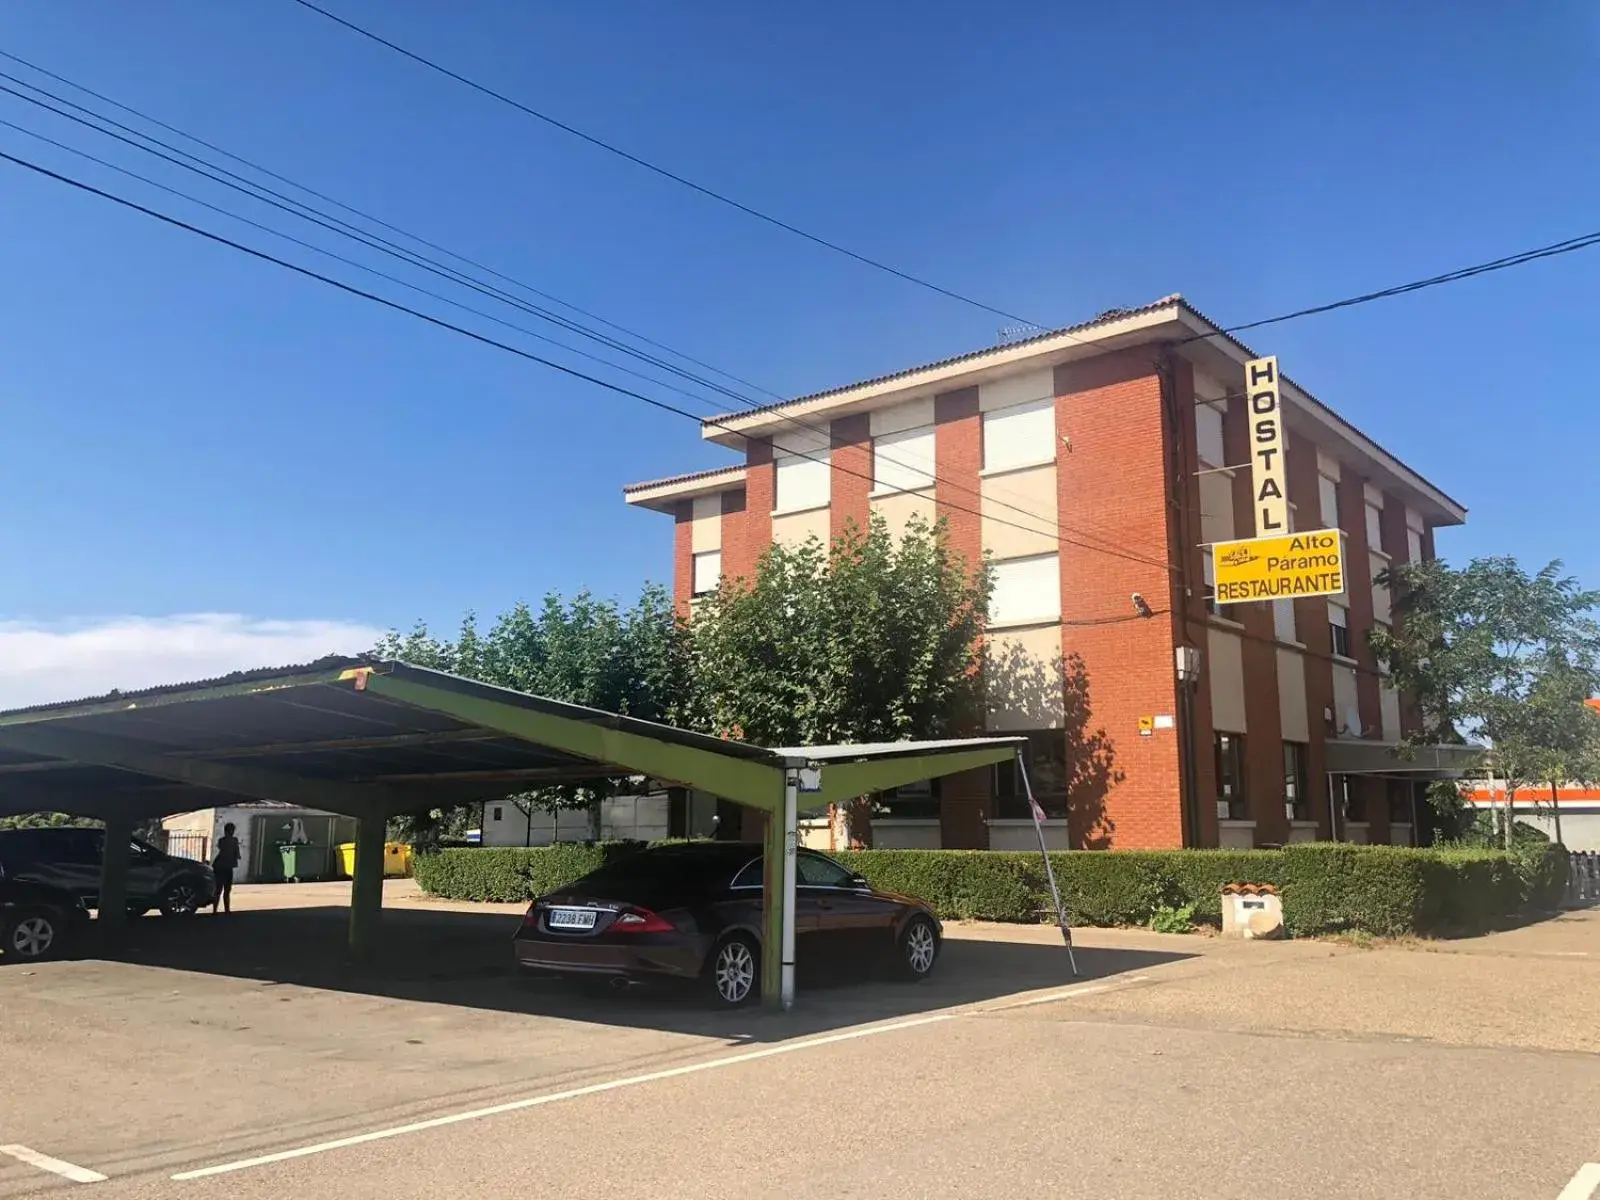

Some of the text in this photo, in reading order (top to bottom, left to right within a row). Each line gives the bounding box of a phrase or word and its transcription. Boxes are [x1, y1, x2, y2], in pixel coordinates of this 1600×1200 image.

[1251, 362, 1282, 530] HOSTAL
[1289, 536, 1334, 552] Alto
[1267, 553, 1339, 572] Páramo
[1217, 572, 1342, 600] RESTAURANTE
